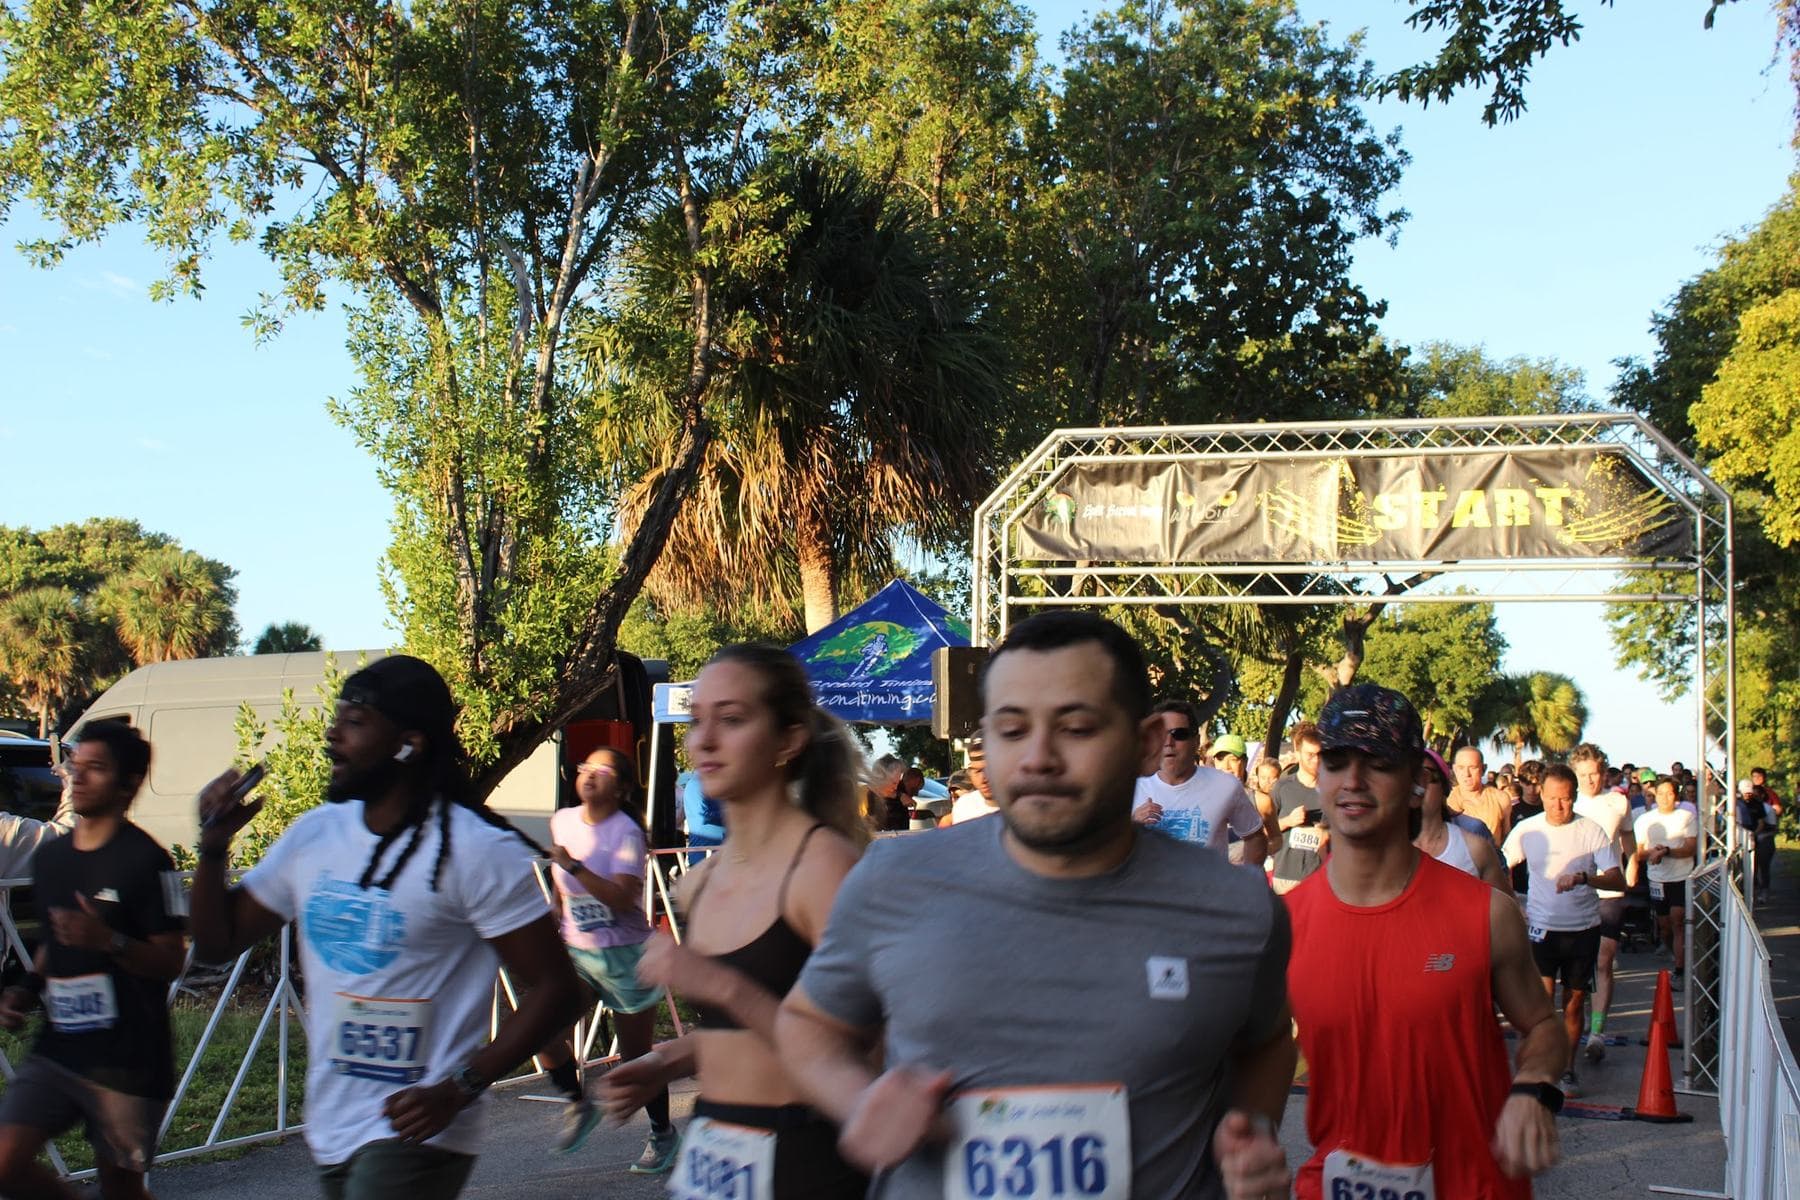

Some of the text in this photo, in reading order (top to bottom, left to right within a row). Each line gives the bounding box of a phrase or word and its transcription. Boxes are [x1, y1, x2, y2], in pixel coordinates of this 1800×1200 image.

[1373, 487, 1571, 530] START
[340, 1021, 425, 1061] 6537
[964, 1132, 1107, 1198] 6316
